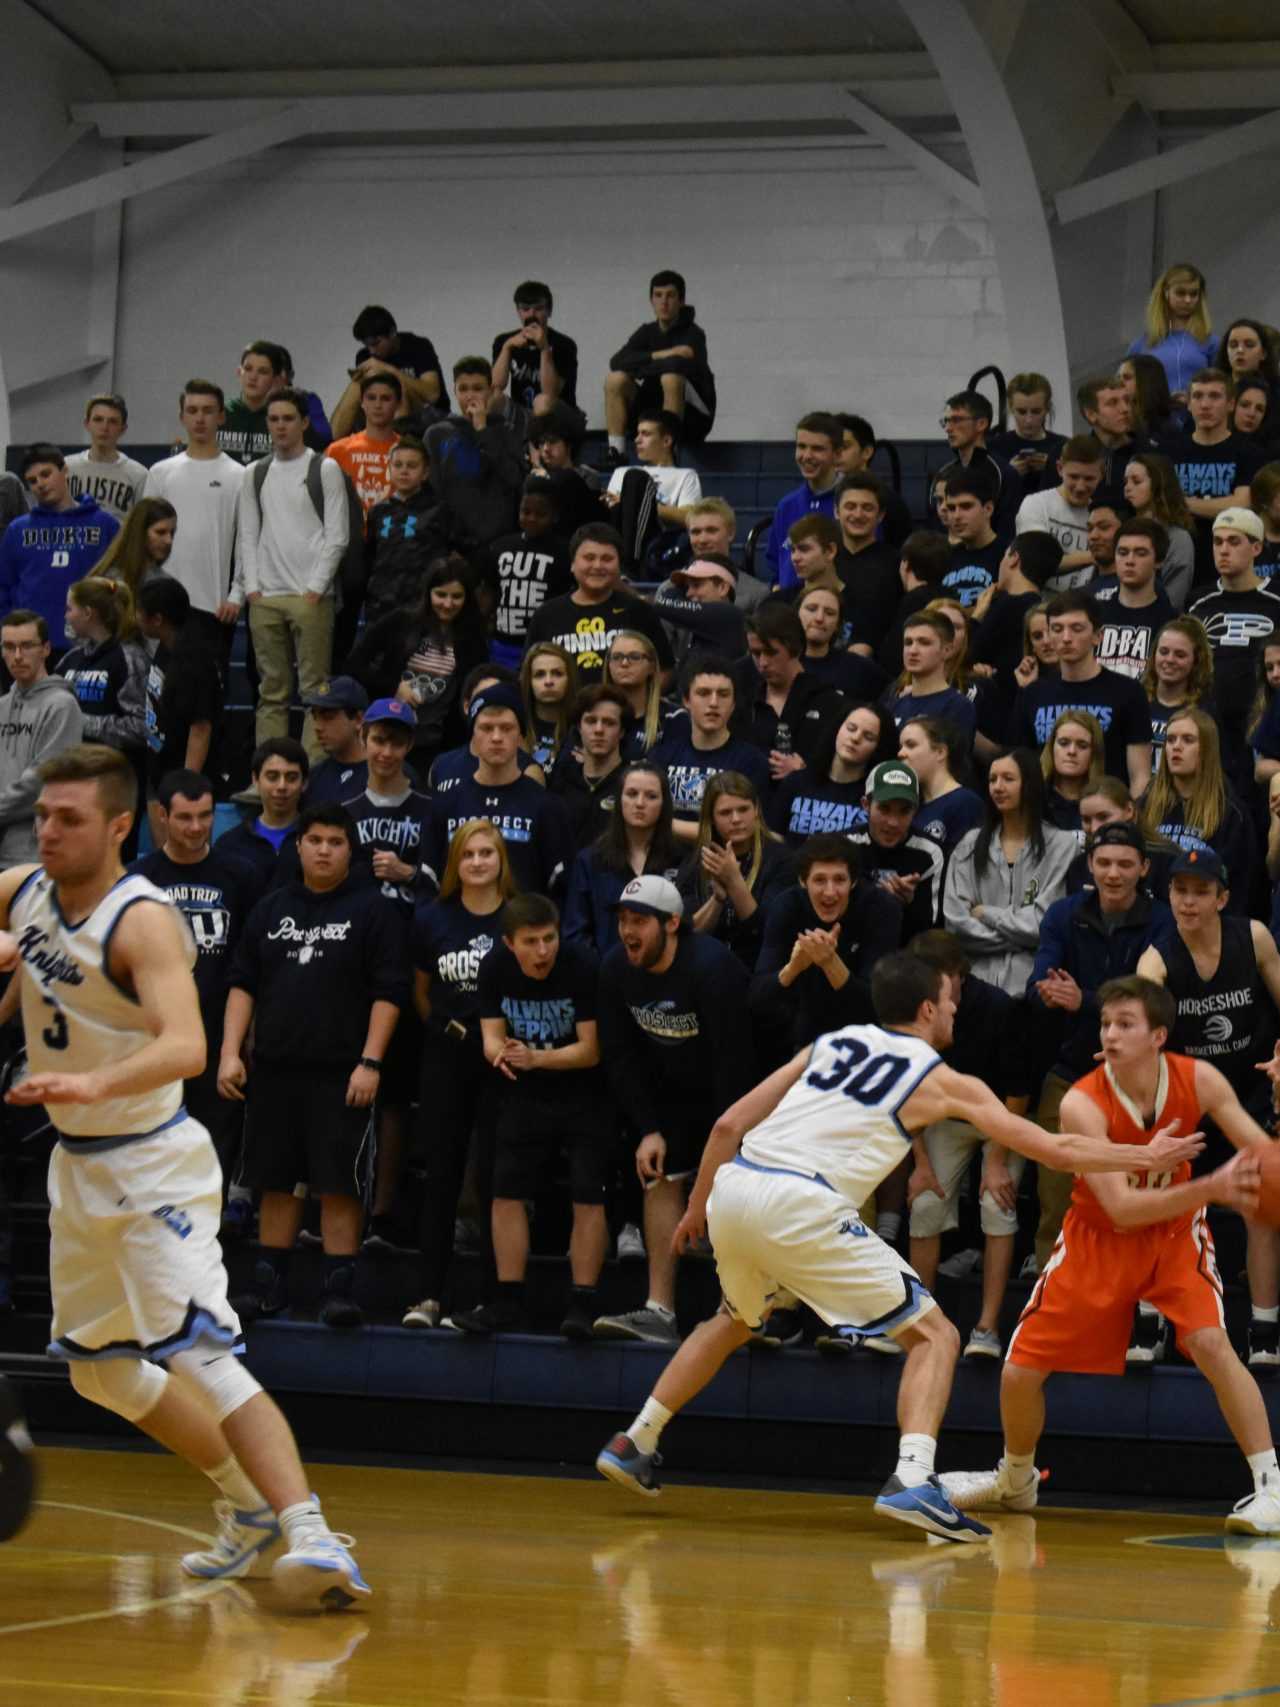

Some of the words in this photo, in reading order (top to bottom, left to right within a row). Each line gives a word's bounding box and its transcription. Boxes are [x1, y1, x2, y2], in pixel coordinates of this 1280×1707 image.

[22, 526, 101, 548] DUKE
[497, 551, 555, 580] CUT
[499, 578, 549, 610] THE
[575, 616, 607, 635] GO
[190, 886, 220, 903] TRIP
[1177, 990, 1254, 1017] HORSESHOE
[807, 1037, 912, 1107] 30
